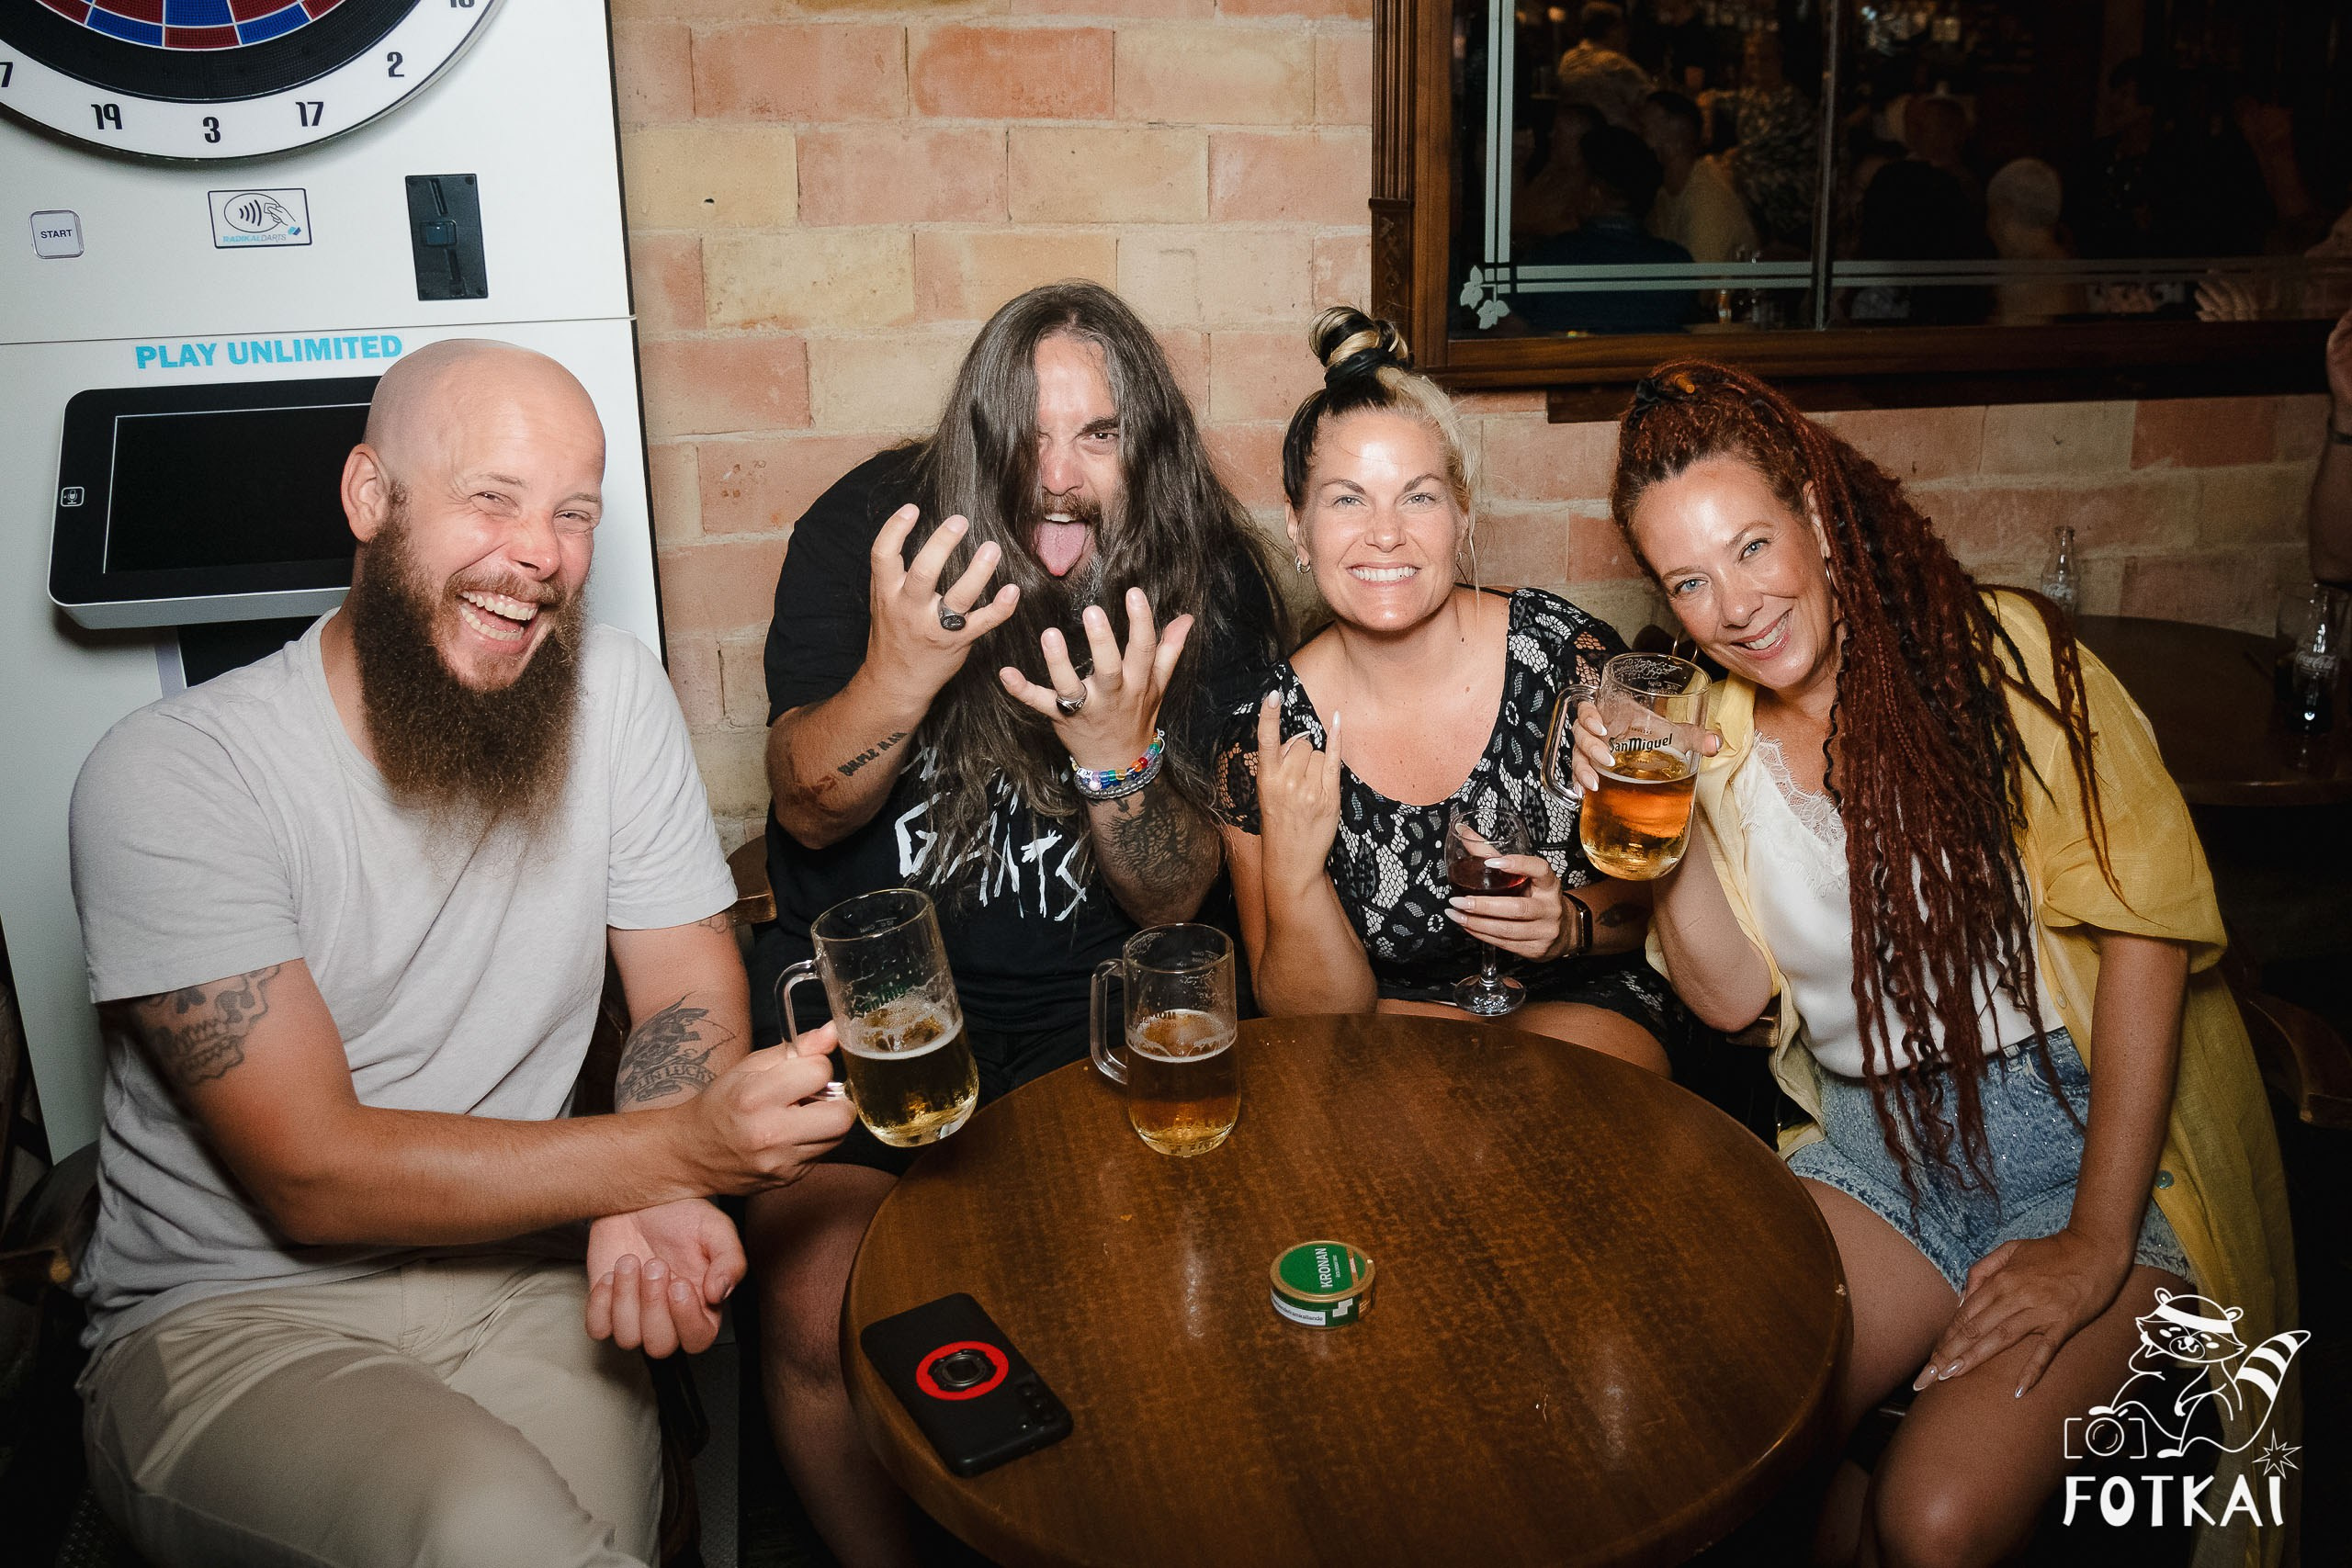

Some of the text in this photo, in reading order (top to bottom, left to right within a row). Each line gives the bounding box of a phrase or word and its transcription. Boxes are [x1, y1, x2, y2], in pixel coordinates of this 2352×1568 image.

[387, 51, 404, 77] 2
[91, 103, 123, 130] 19
[295, 101, 324, 127] 17
[202, 116, 221, 143] 3
[40, 229, 73, 239] START
[135, 334, 403, 369] PLAY UNLIMITED
[1315, 1247, 1333, 1288] KRONAN
